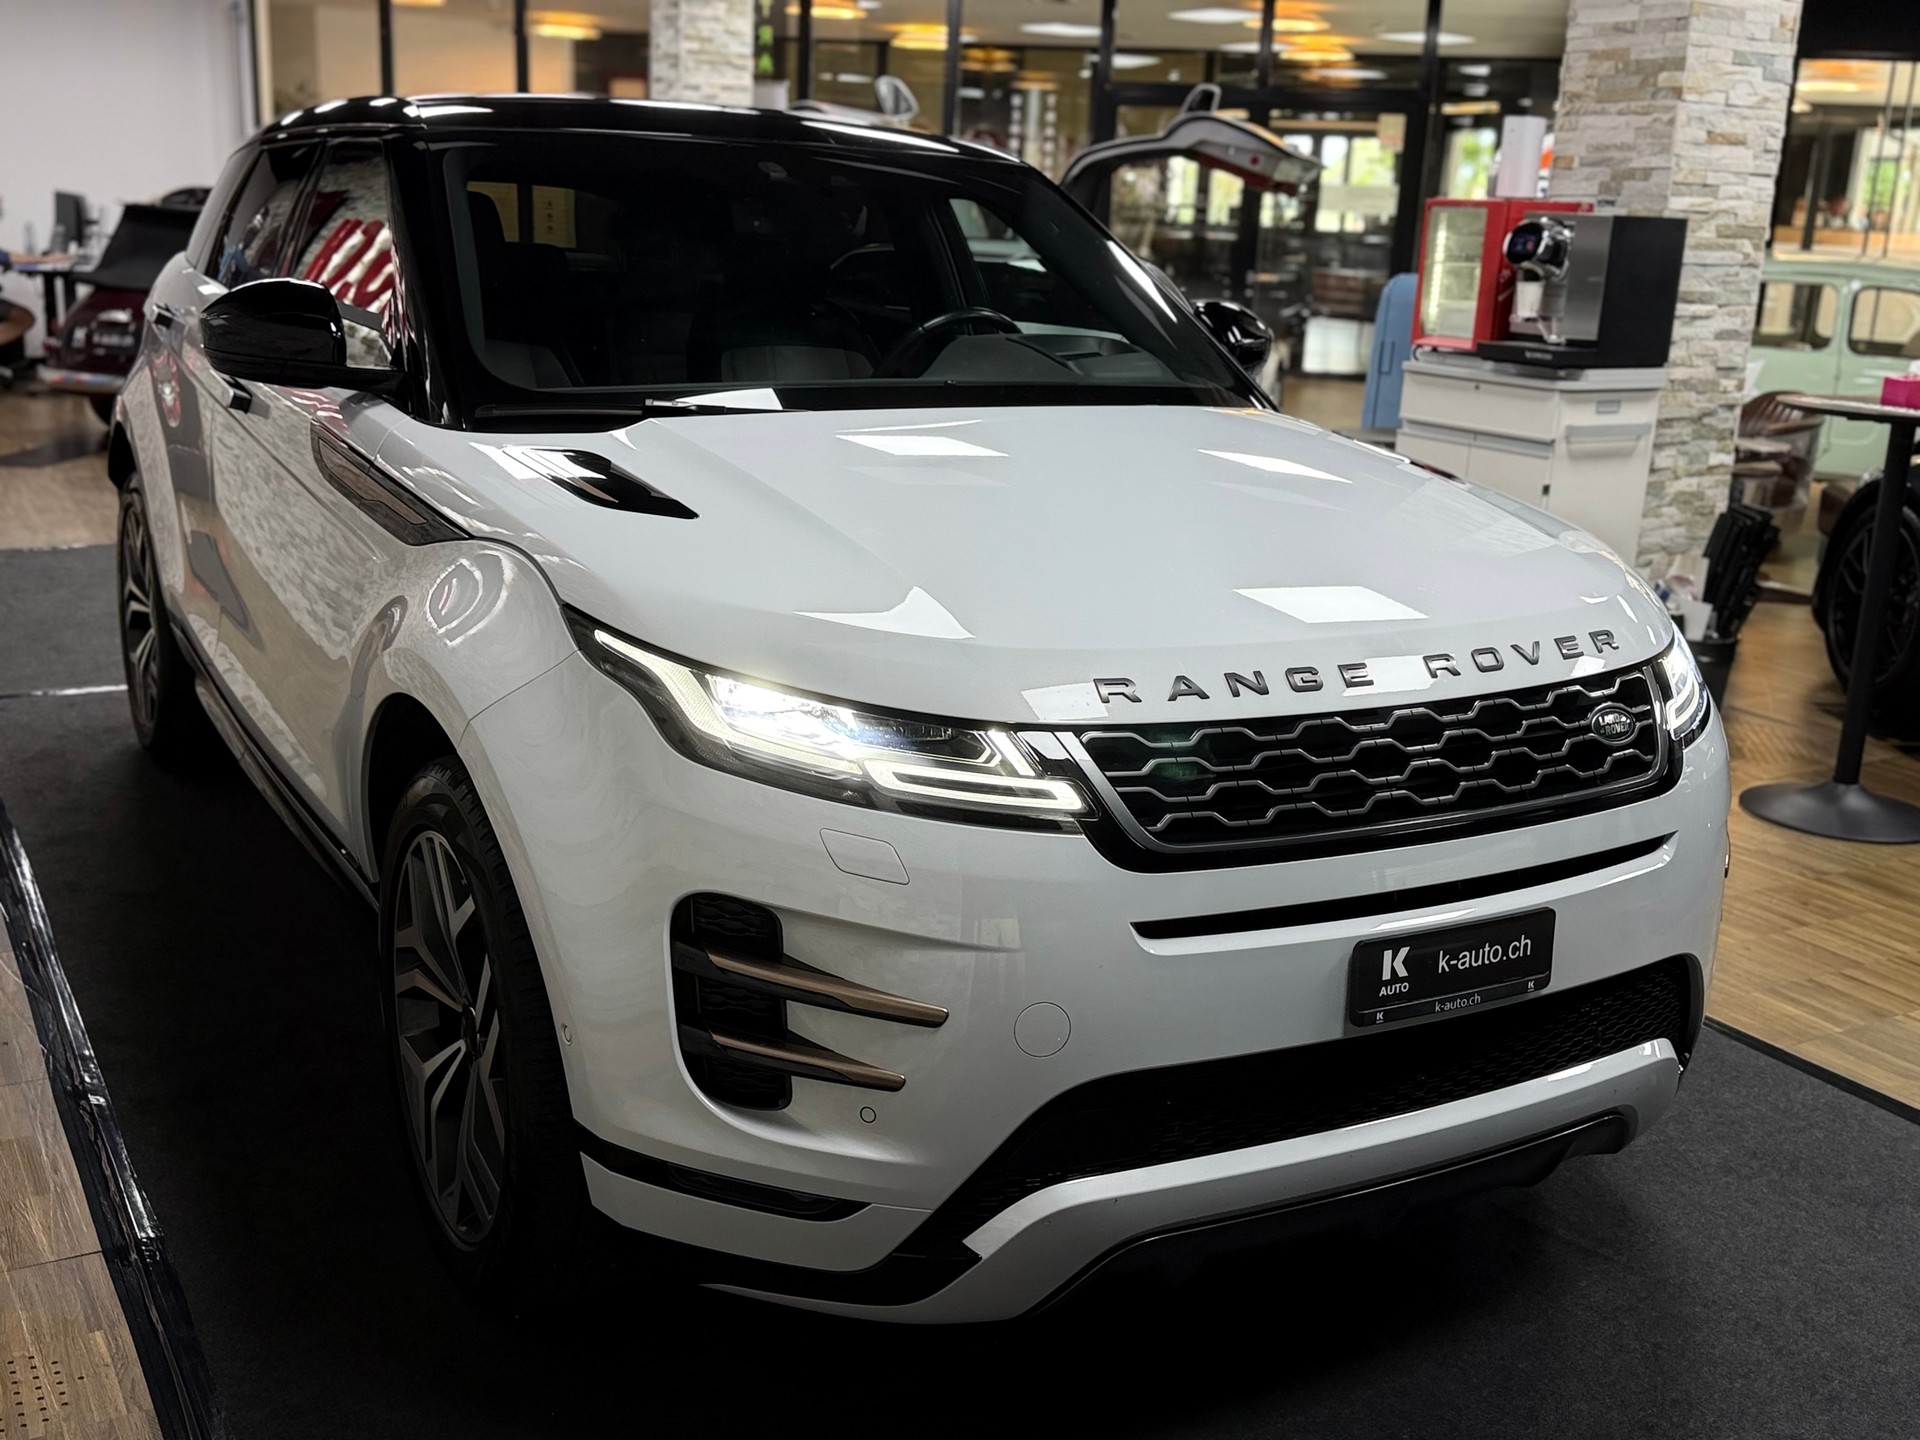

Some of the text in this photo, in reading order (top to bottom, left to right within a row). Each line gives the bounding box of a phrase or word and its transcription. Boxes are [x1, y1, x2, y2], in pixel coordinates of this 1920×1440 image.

[1092, 627, 1619, 704] RANGE ROVER
[1605, 722, 1630, 736] ROVER
[1381, 946, 1411, 981] K
[1438, 934, 1532, 974] k-auto.ch
[1378, 982, 1409, 997] AUTO
[1435, 993, 1481, 1013] k-auto.ch
